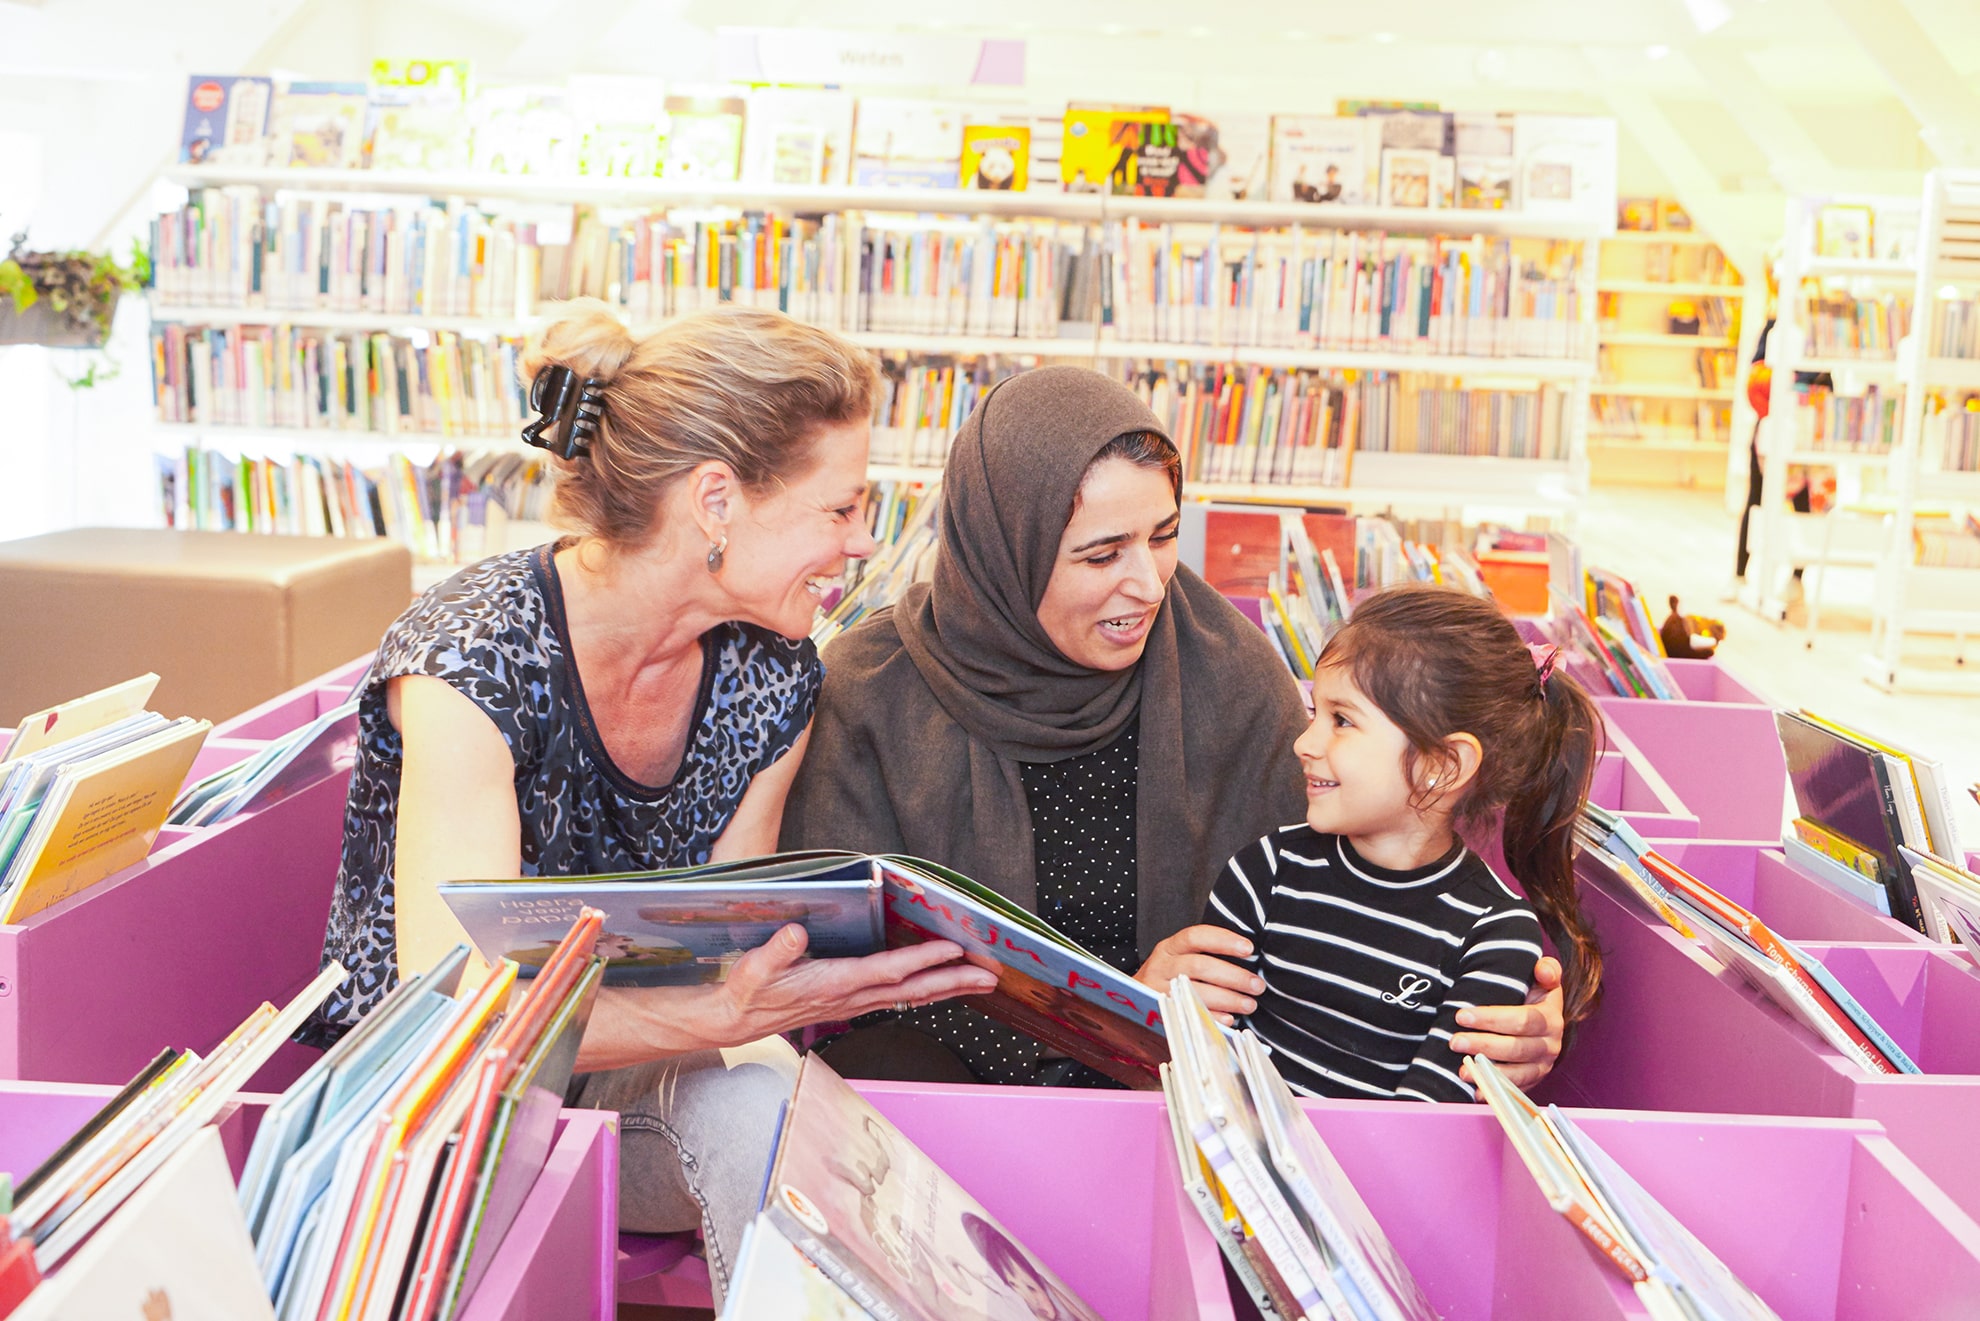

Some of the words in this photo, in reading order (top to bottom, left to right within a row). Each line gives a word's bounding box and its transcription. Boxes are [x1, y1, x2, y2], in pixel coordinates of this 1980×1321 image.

[500, 898, 585, 909] Hoera
[1765, 943, 1786, 965] Tom
[1266, 1192, 1282, 1211] van
[1280, 1213, 1307, 1255] Straaten
[1203, 1202, 1230, 1238] Harmen
[1226, 1239, 1240, 1256] van
[1237, 1257, 1262, 1292] Straaten
